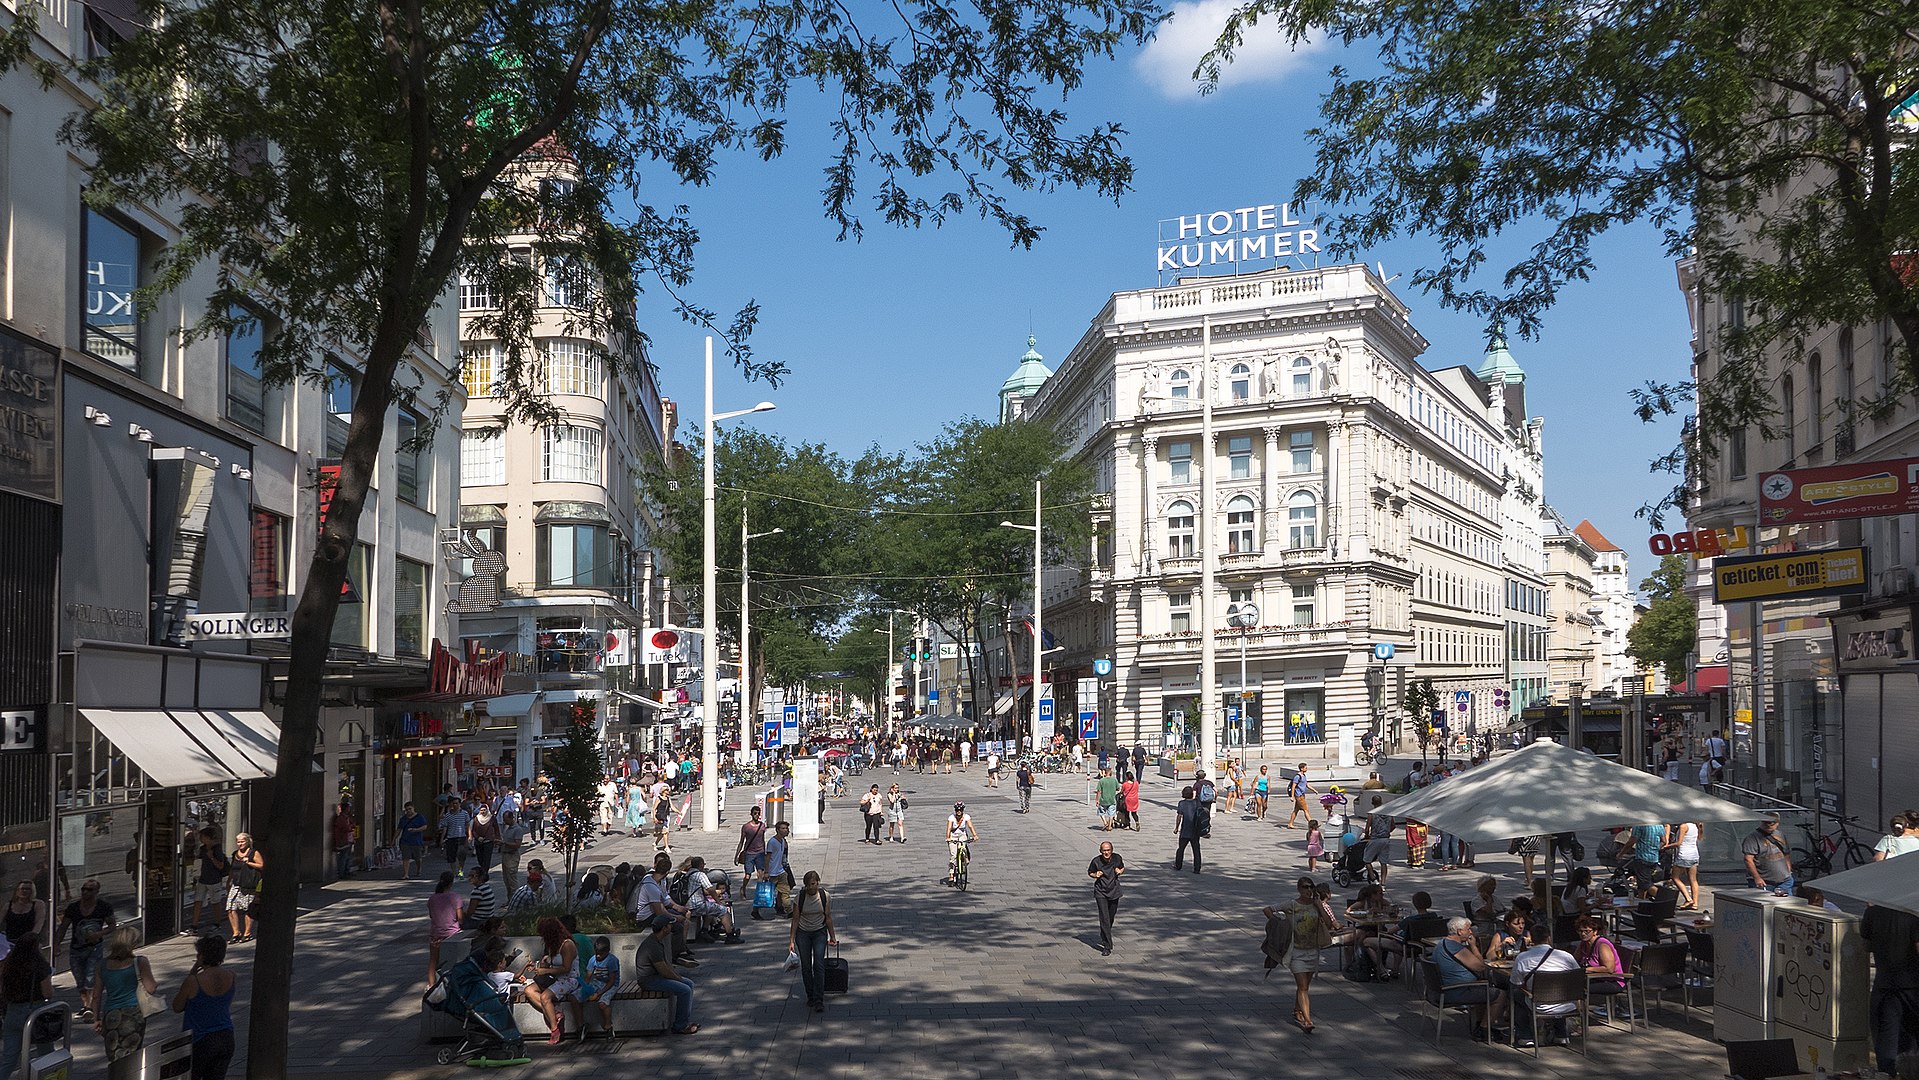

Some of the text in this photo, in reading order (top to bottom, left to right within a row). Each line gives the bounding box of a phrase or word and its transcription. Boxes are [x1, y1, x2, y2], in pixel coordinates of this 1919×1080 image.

[1179, 203, 1300, 240] HOTEL
[1157, 229, 1322, 271] KUMMER
[189, 617, 290, 637] SOLINGER
[648, 651, 682, 663] Turek
[1377, 645, 1389, 659] U
[1098, 662, 1109, 674] U
[477, 766, 511, 777] SALE
